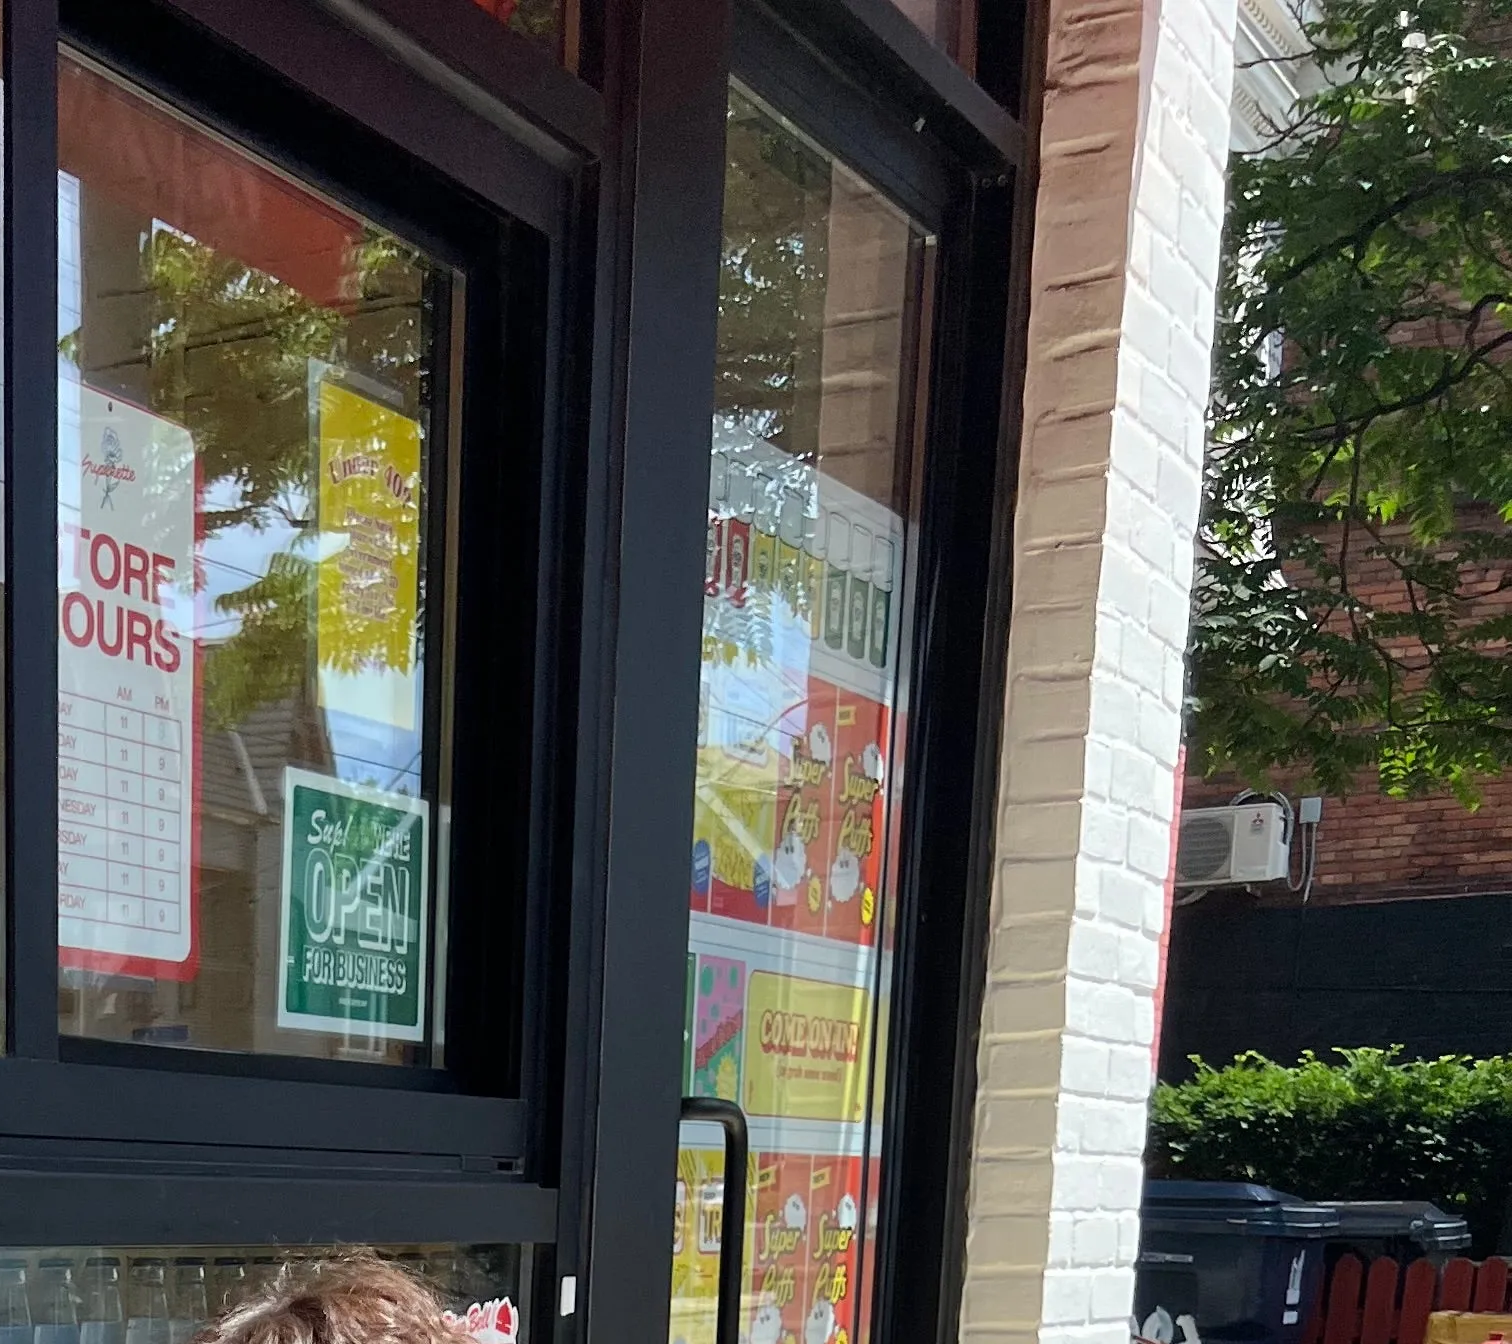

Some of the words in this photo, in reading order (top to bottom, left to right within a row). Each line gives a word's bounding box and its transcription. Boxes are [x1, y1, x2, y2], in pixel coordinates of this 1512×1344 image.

[60, 522, 175, 609] TORE
[62, 592, 181, 673] OURS
[117, 686, 132, 701] AM
[155, 696, 169, 712] PM
[307, 809, 354, 852] Sup!
[304, 848, 410, 955] OPEN
[303, 945, 335, 985] FOR
[336, 951, 407, 995] BUSINESS
[760, 1009, 808, 1056] COME
[808, 1015, 833, 1060] ON
[759, 1213, 800, 1260] Super
[813, 1213, 852, 1259] Super
[758, 1263, 795, 1308] Puffs
[812, 1262, 847, 1305] Puffs
